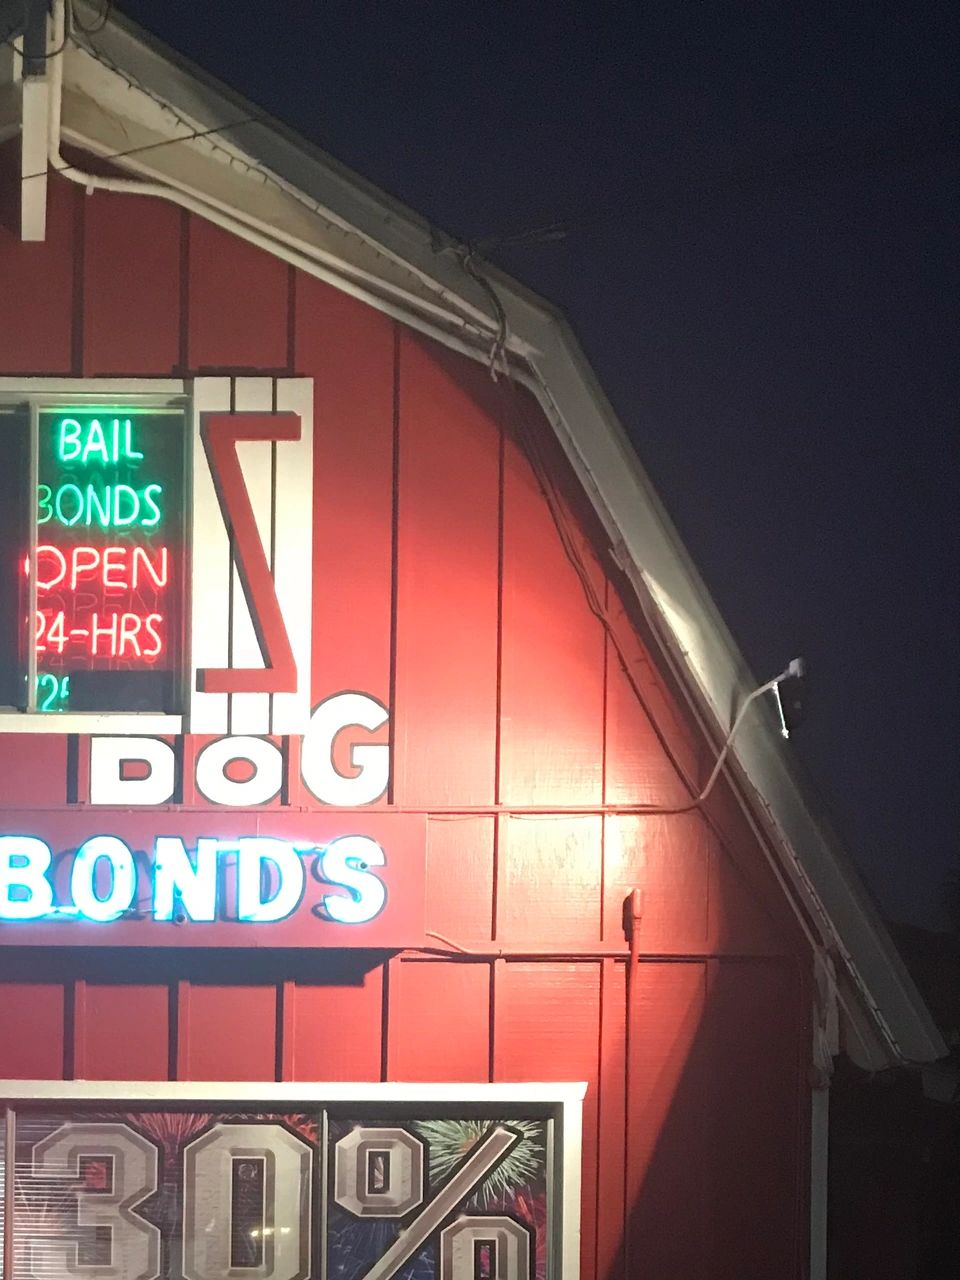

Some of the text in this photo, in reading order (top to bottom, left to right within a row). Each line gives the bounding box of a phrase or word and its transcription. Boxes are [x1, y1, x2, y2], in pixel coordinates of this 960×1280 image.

[59, 418, 144, 462] BAIL
[37, 484, 163, 527] BONDS
[25, 545, 169, 590] OPEN
[28, 611, 163, 657] 24-HRS
[89, 690, 391, 807] DOG
